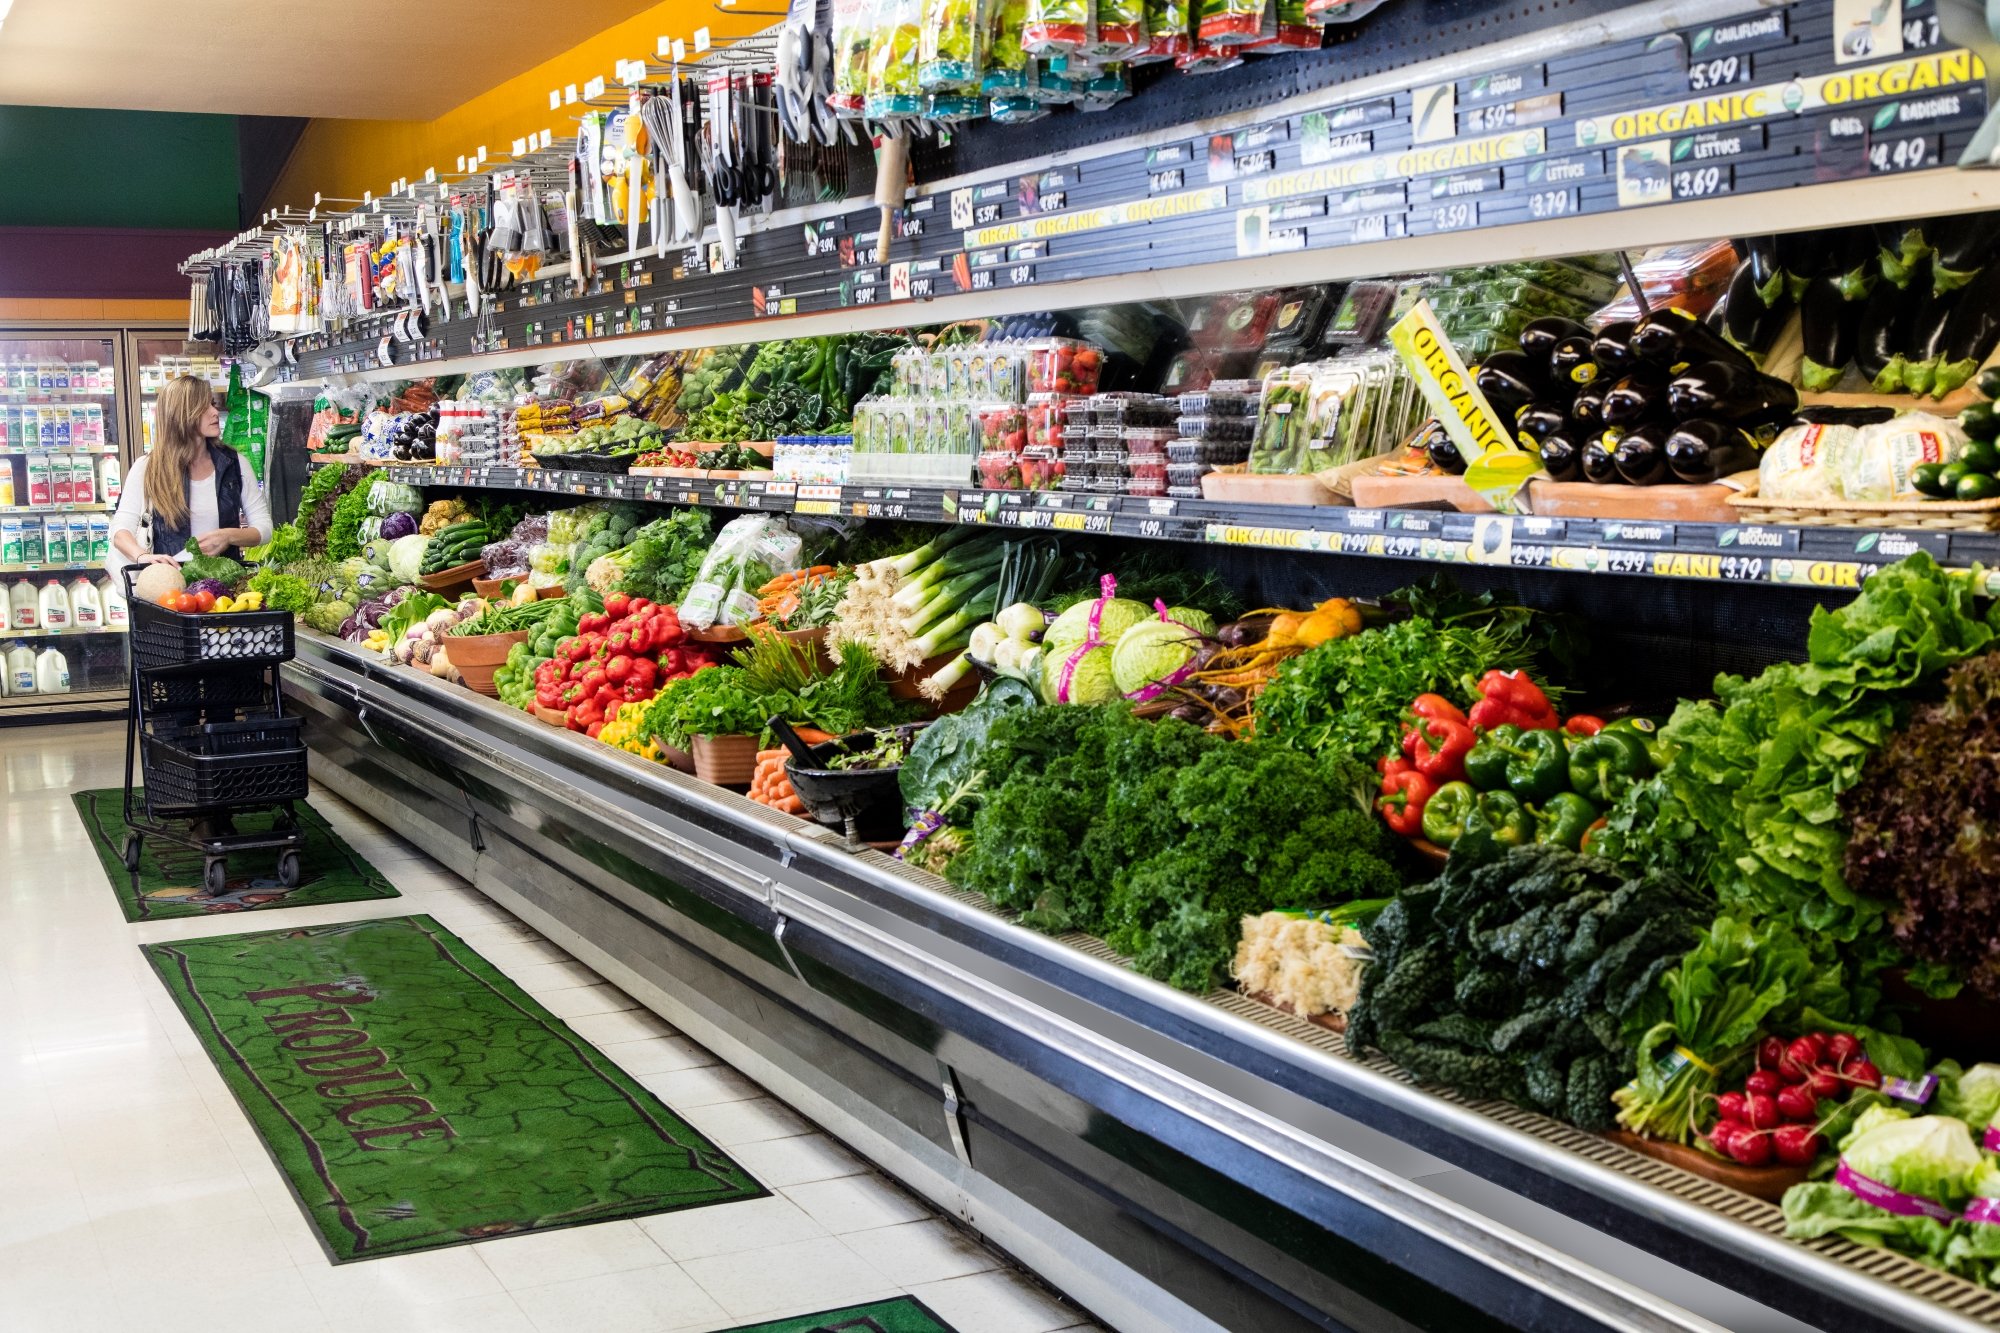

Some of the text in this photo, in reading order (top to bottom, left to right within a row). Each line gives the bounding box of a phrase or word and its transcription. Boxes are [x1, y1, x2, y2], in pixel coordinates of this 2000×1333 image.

[1714, 16, 1781, 44] CAULIFLOWER
[1689, 56, 1739, 90] $5.99
[1612, 91, 1767, 141] ORGANIC
[1900, 95, 1961, 122] RADISHES
[1397, 135, 1517, 177] ORGANIC
[1694, 137, 1742, 160] LETTUCE
[1870, 137, 1926, 172] $4.49
[1266, 163, 1364, 199] ORGANIC
[1546, 163, 1586, 182] LETTUCE
[1673, 166, 1720, 198] $3.69
[1449, 178, 1484, 196] LETTUCE
[1126, 191, 1206, 222] ORGANIC
[1035, 209, 1104, 237] ORGANIC
[1225, 526, 1305, 547] ORGANIC
[1621, 526, 1662, 541] CILANTRO
[1738, 531, 1783, 547] BROCCOLI
[244, 977, 460, 1151] PRODUCE
